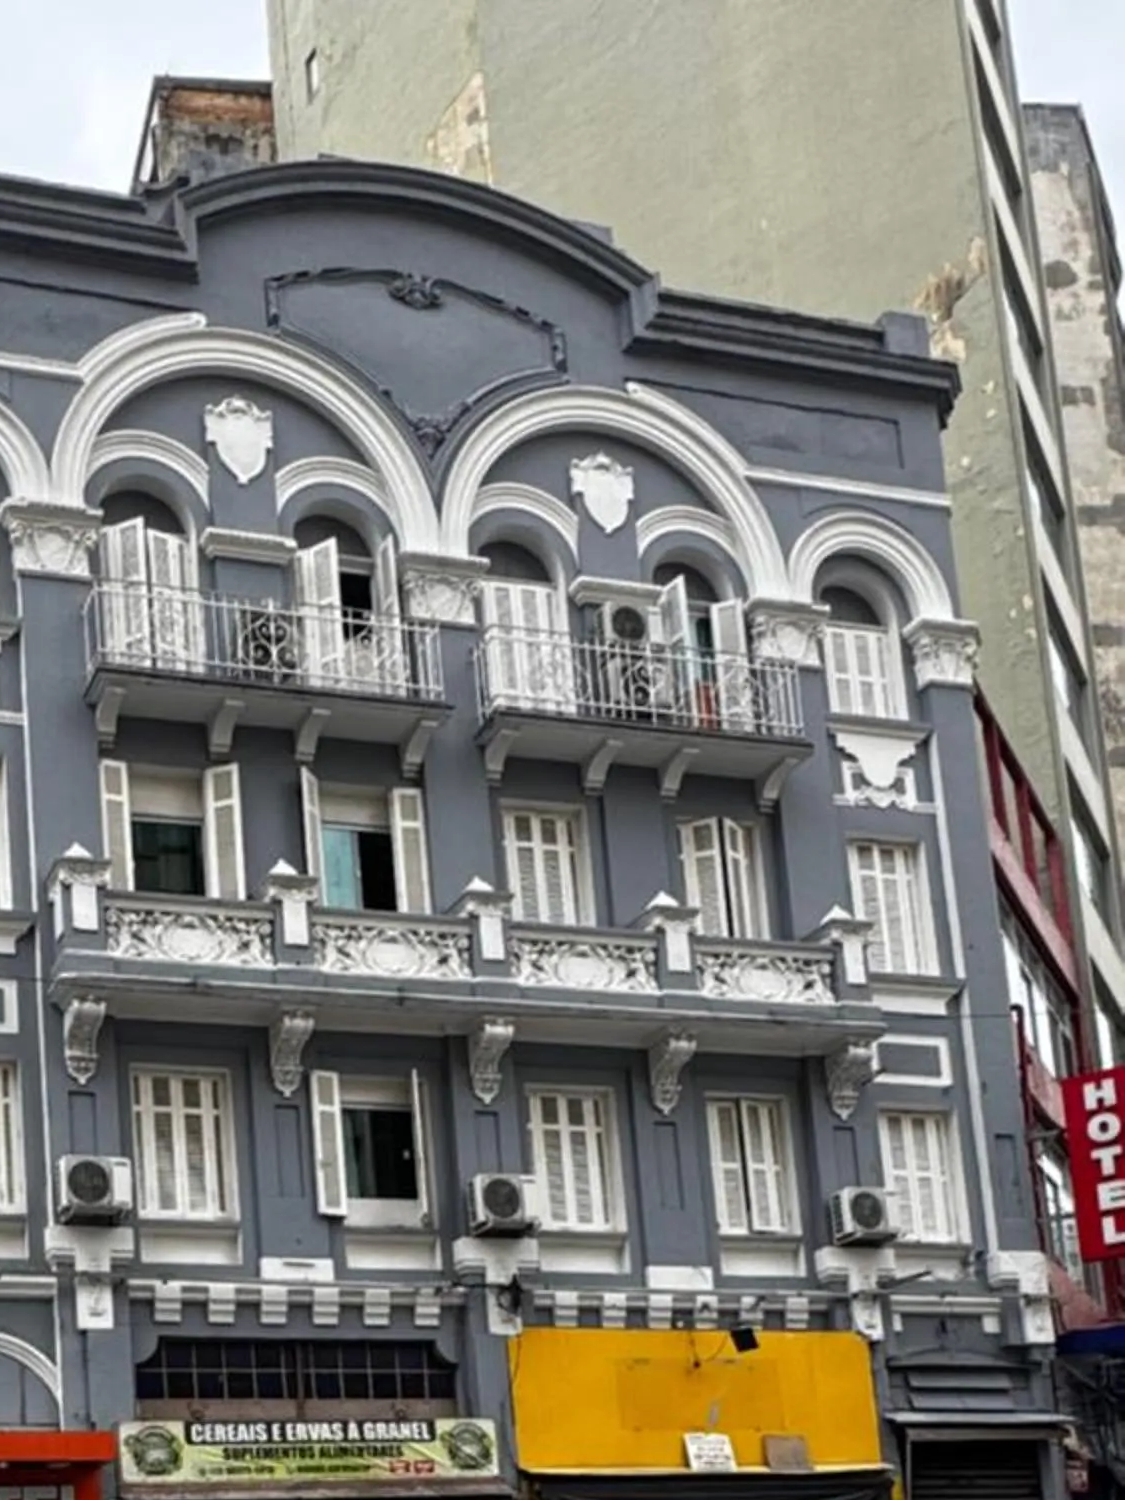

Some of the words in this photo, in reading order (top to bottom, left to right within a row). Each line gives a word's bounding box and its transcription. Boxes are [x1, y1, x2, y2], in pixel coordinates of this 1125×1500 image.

[1083, 1078, 1125, 1246] HOTEL
[190, 1423, 268, 1442] CEREAIS
[271, 1423, 283, 1441] E
[286, 1421, 344, 1441] ERVAS
[363, 1421, 431, 1440] GRANEL
